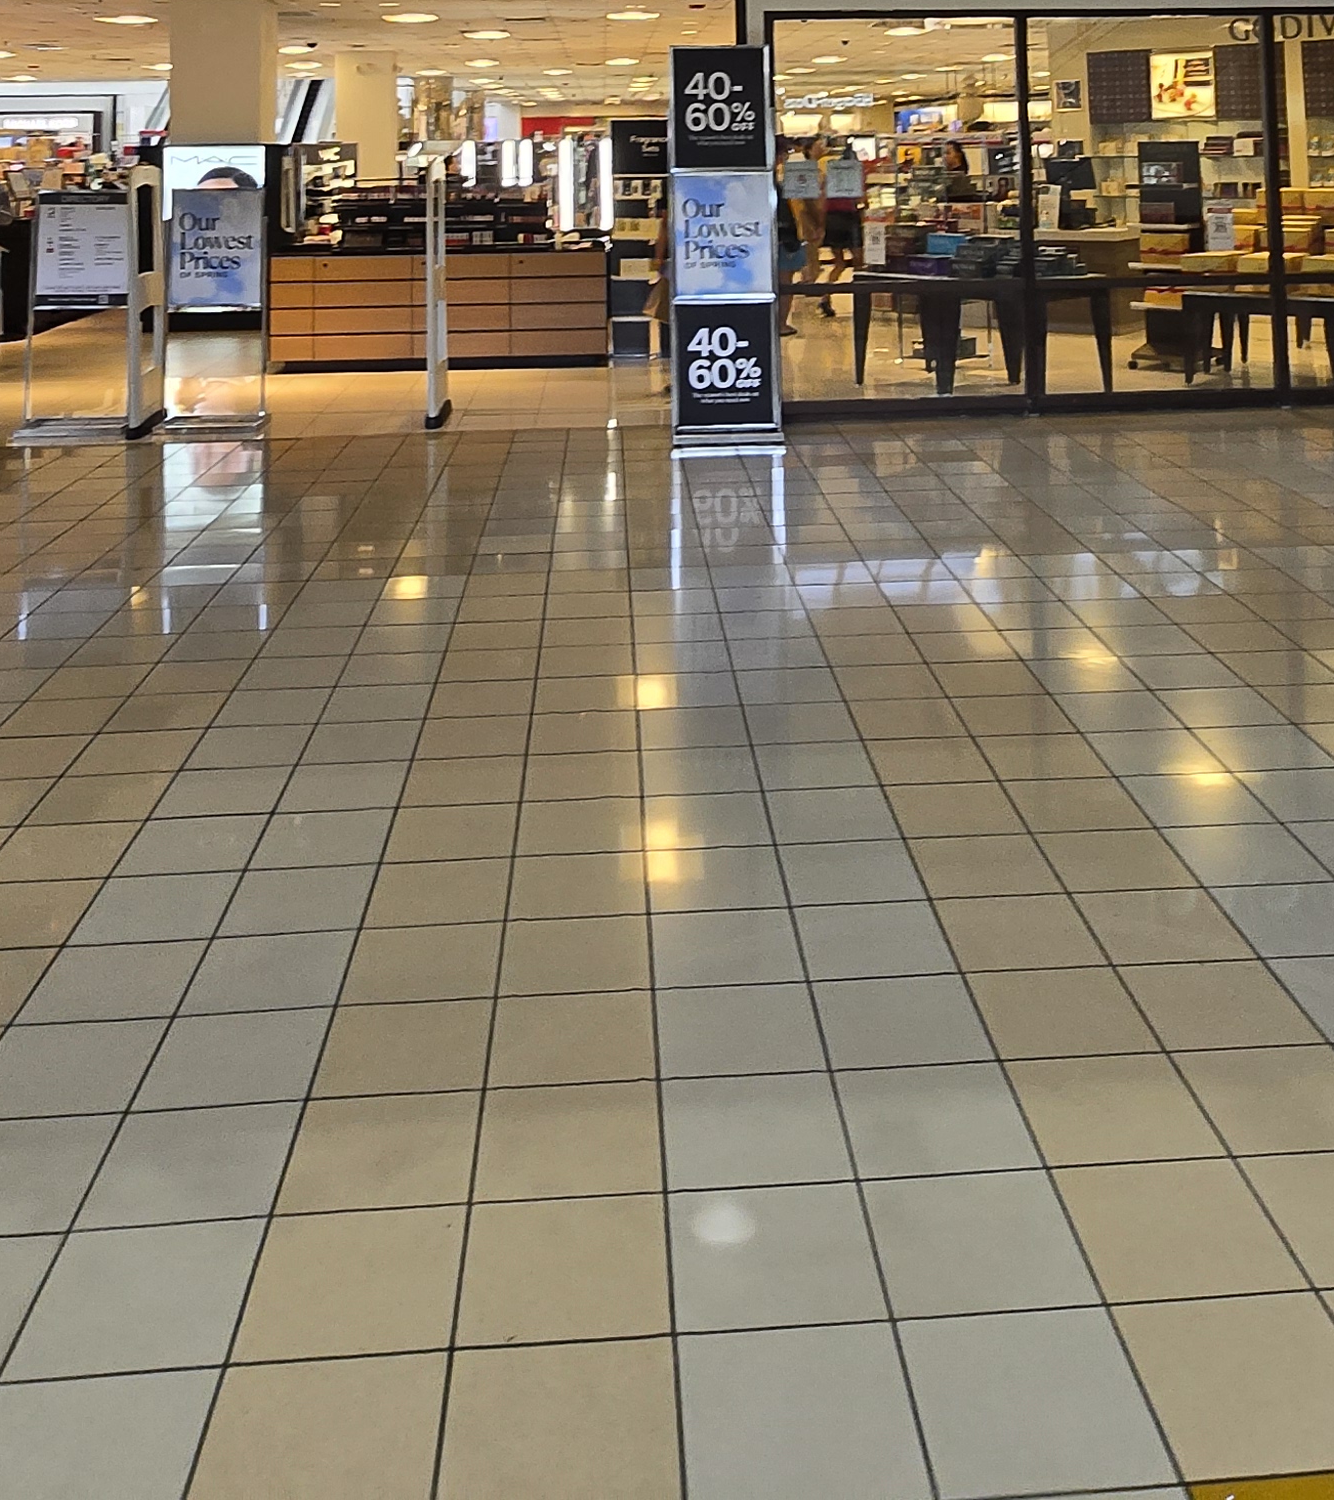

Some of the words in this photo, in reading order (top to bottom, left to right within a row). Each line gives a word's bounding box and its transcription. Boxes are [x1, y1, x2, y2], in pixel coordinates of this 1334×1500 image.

[683, 71, 744, 101] 40-
[685, 101, 756, 132] 60%
[681, 198, 725, 218] Our
[178, 212, 220, 231] Our
[684, 219, 762, 239] Lowest
[180, 232, 254, 250] Lowest
[685, 240, 750, 260] Prices
[180, 250, 241, 270] Prices
[687, 326, 749, 357] 40-
[688, 357, 762, 390] 60%
